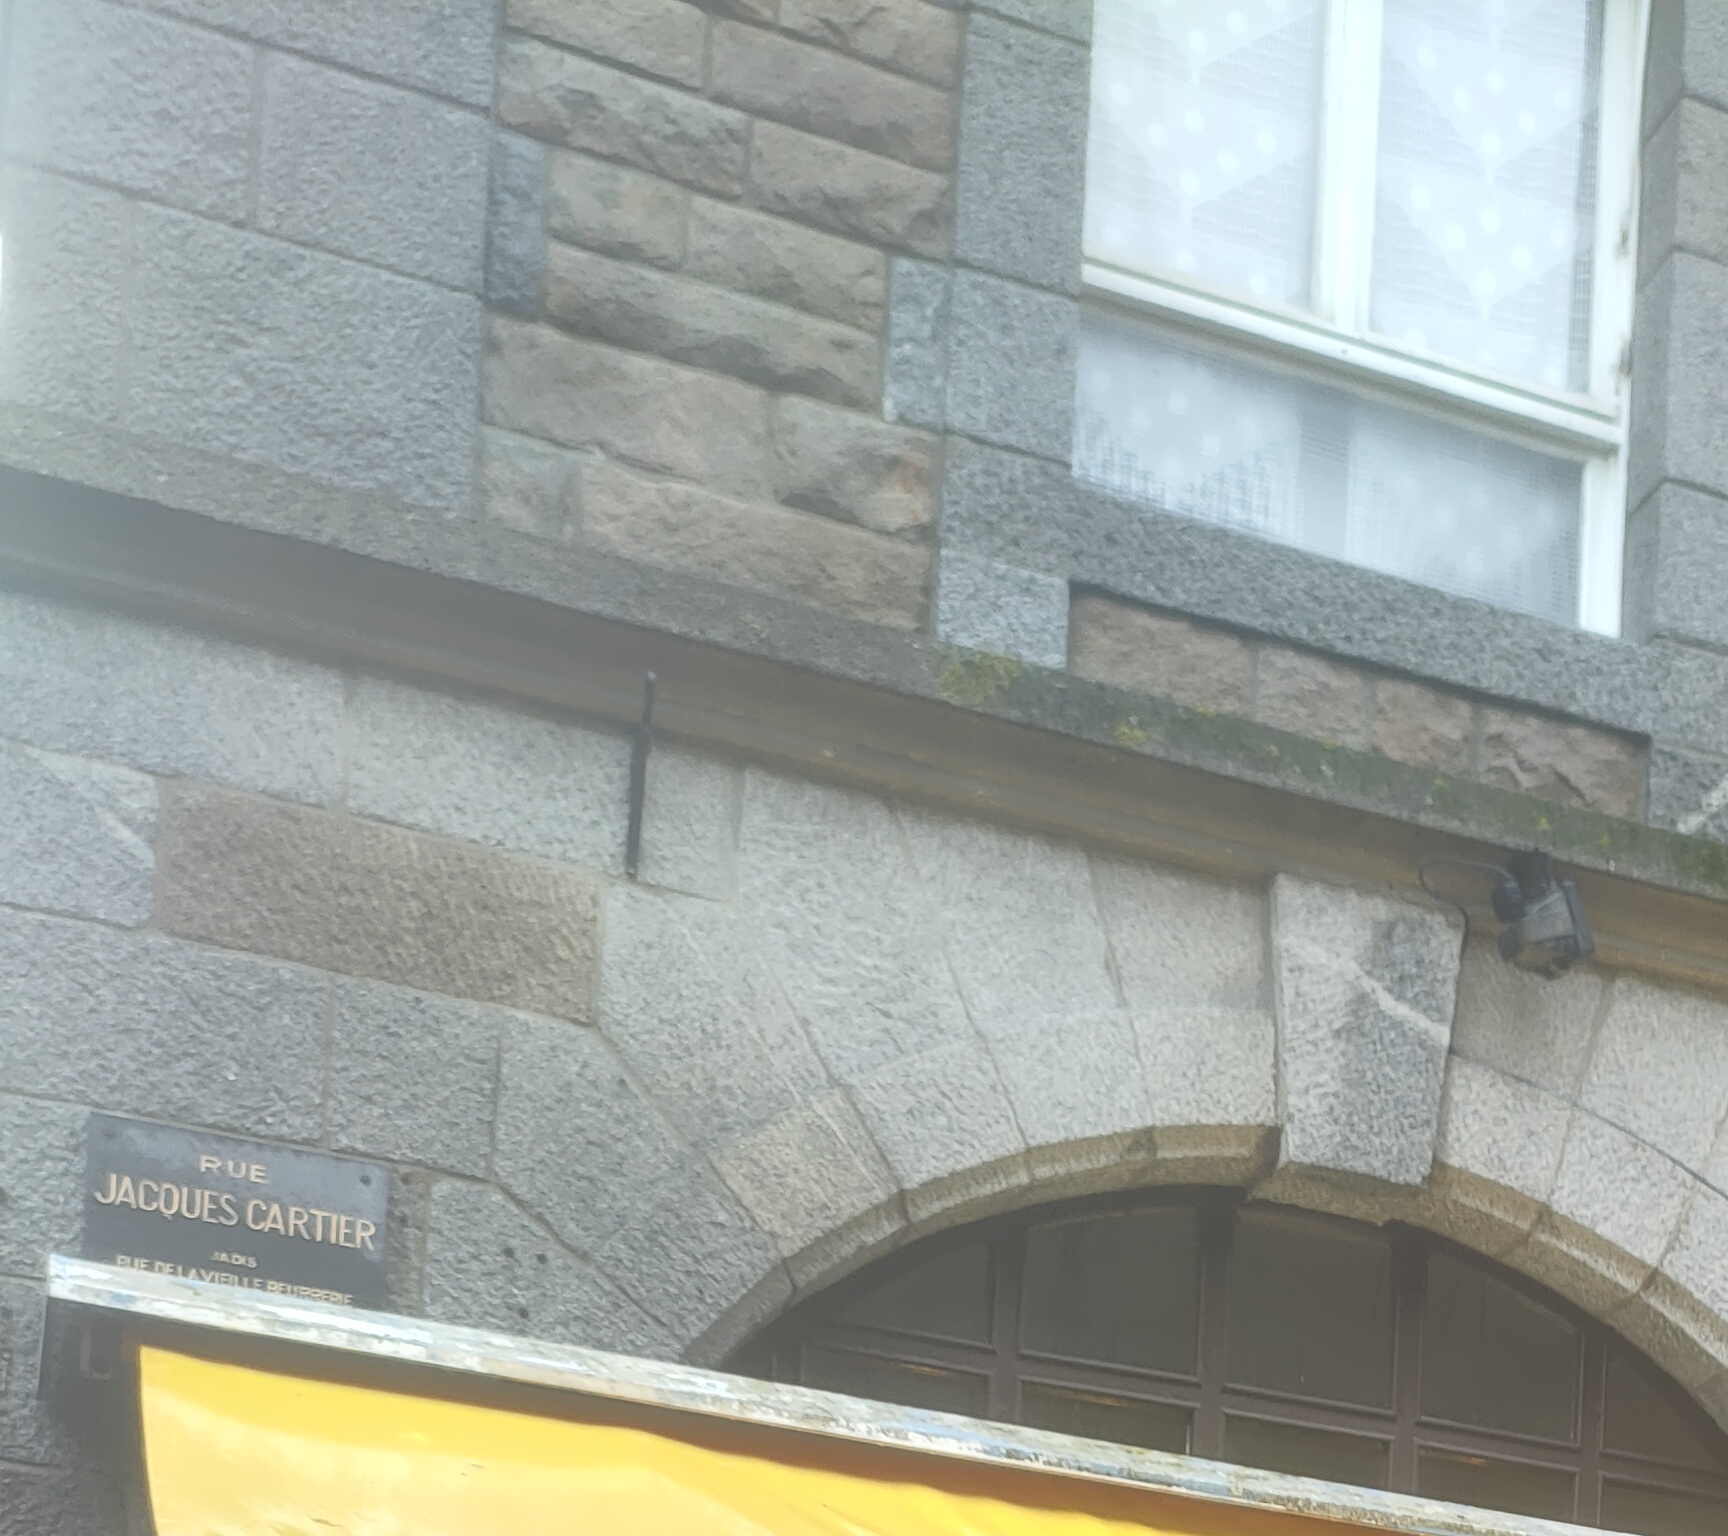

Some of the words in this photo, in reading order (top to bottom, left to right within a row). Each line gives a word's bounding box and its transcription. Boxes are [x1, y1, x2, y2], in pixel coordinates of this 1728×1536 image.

[198, 1154, 270, 1184] RUE
[93, 1172, 239, 1226] JACQUES
[246, 1197, 378, 1251] CARTIER
[209, 1251, 257, 1268] JADIS
